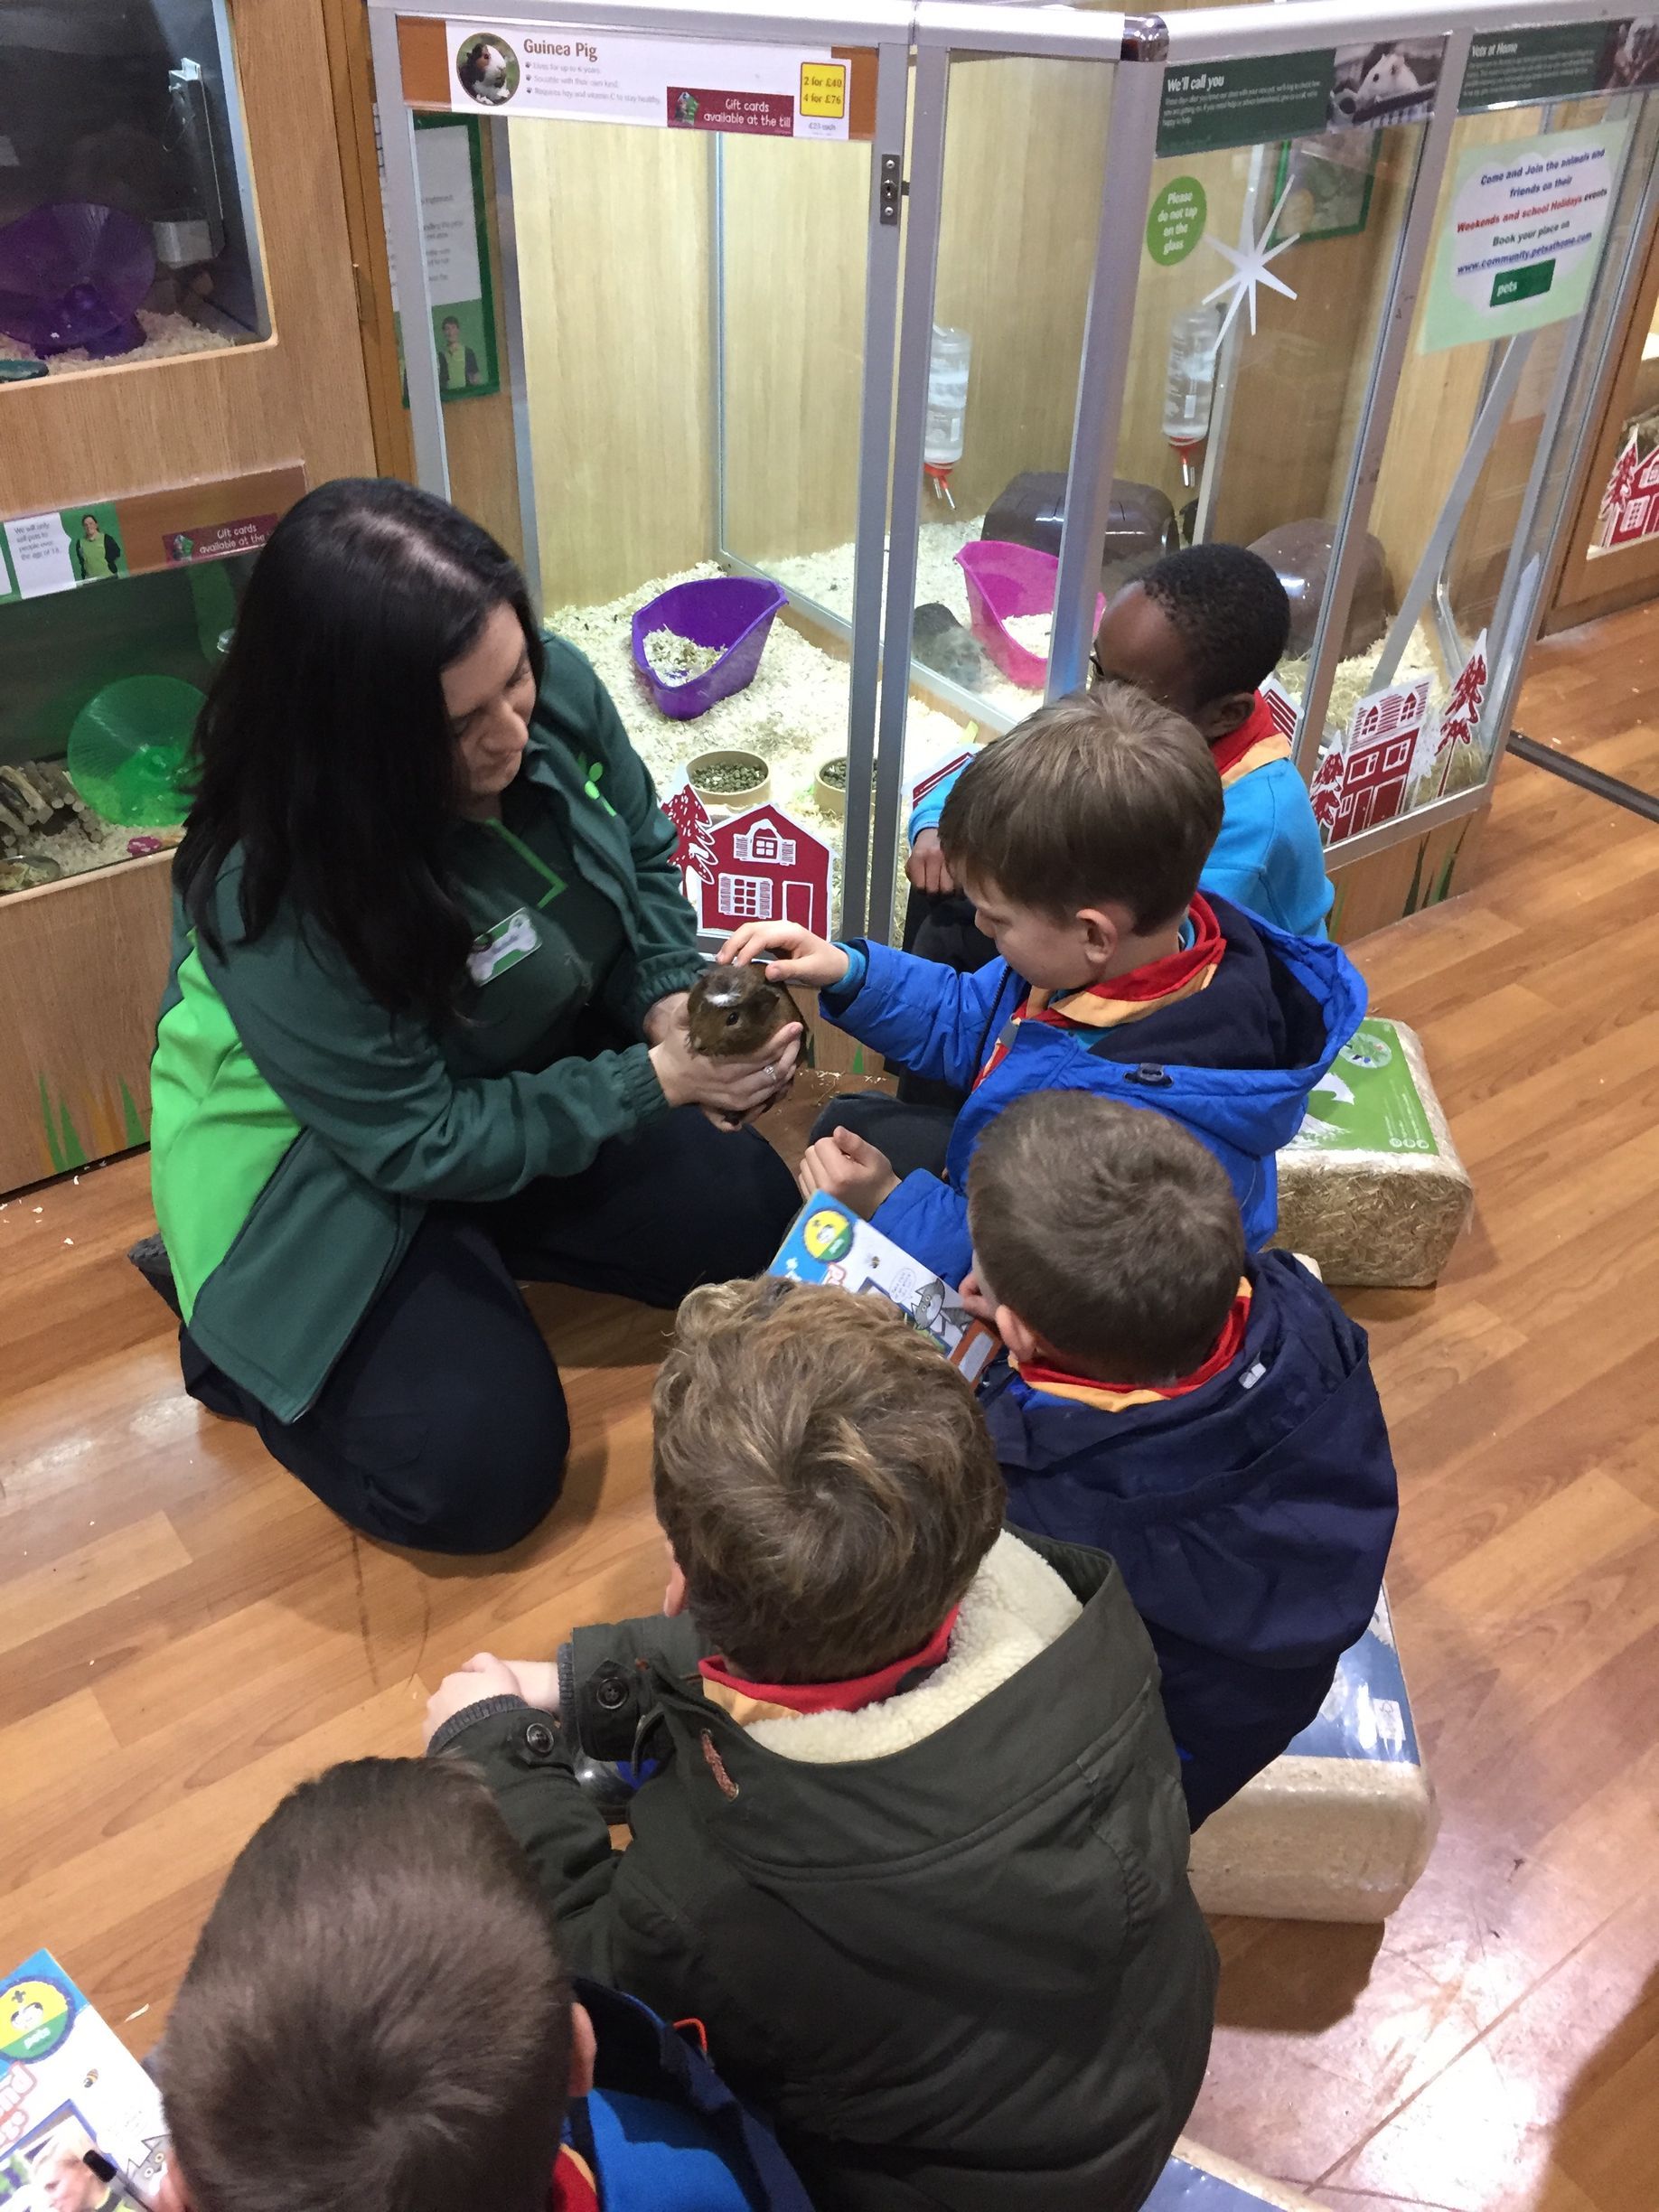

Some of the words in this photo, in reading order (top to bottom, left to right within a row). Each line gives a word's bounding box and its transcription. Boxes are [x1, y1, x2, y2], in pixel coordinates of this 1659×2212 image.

[523, 38, 571, 57] Guinea
[576, 42, 598, 62] Pig
[803, 76, 811, 86] 2
[812, 77, 823, 87] for
[825, 78, 843, 88] £40
[1167, 76, 1189, 92] We'll
[1190, 74, 1206, 89] call
[1207, 75, 1225, 91] you
[725, 98, 741, 111] Gift
[744, 100, 770, 113] cards
[803, 93, 810, 102] 4
[811, 94, 822, 103] for
[824, 95, 841, 105] £76
[703, 112, 745, 125] available
[746, 114, 759, 126] at
[760, 115, 777, 127] the
[779, 116, 791, 127] till
[1480, 173, 1504, 186] Come
[1506, 167, 1523, 180] and
[1525, 165, 1544, 176] Join
[1546, 161, 1559, 172] the
[1561, 154, 1590, 168] animals
[1591, 148, 1606, 160] and
[1509, 186, 1541, 198] friends
[1542, 183, 1552, 192] on
[1554, 176, 1572, 188] their
[1167, 192, 1193, 205] Please
[1158, 210, 1169, 223] do
[1169, 208, 1184, 220] not
[1185, 206, 1198, 220] tap
[1457, 215, 1500, 233] Weekends
[1503, 211, 1520, 223] and
[1522, 203, 1550, 219] school
[1551, 196, 1582, 211] Holidays
[1584, 188, 1607, 202] events
[1163, 227, 1175, 237] on
[1176, 222, 1188, 235] the
[1492, 235, 1516, 247] Book
[1517, 230, 1536, 243] your
[1537, 225, 1560, 239] place
[1561, 220, 1570, 229] on
[1163, 239, 1185, 256] glass
[1457, 231, 1592, 275] www.community.petsathome.com
[1496, 280, 1518, 297] pets
[217, 530, 231, 539] Gift
[234, 523, 258, 536] cards
[200, 539, 237, 554] available
[239, 537, 249, 546] at
[250, 534, 266, 543] the
